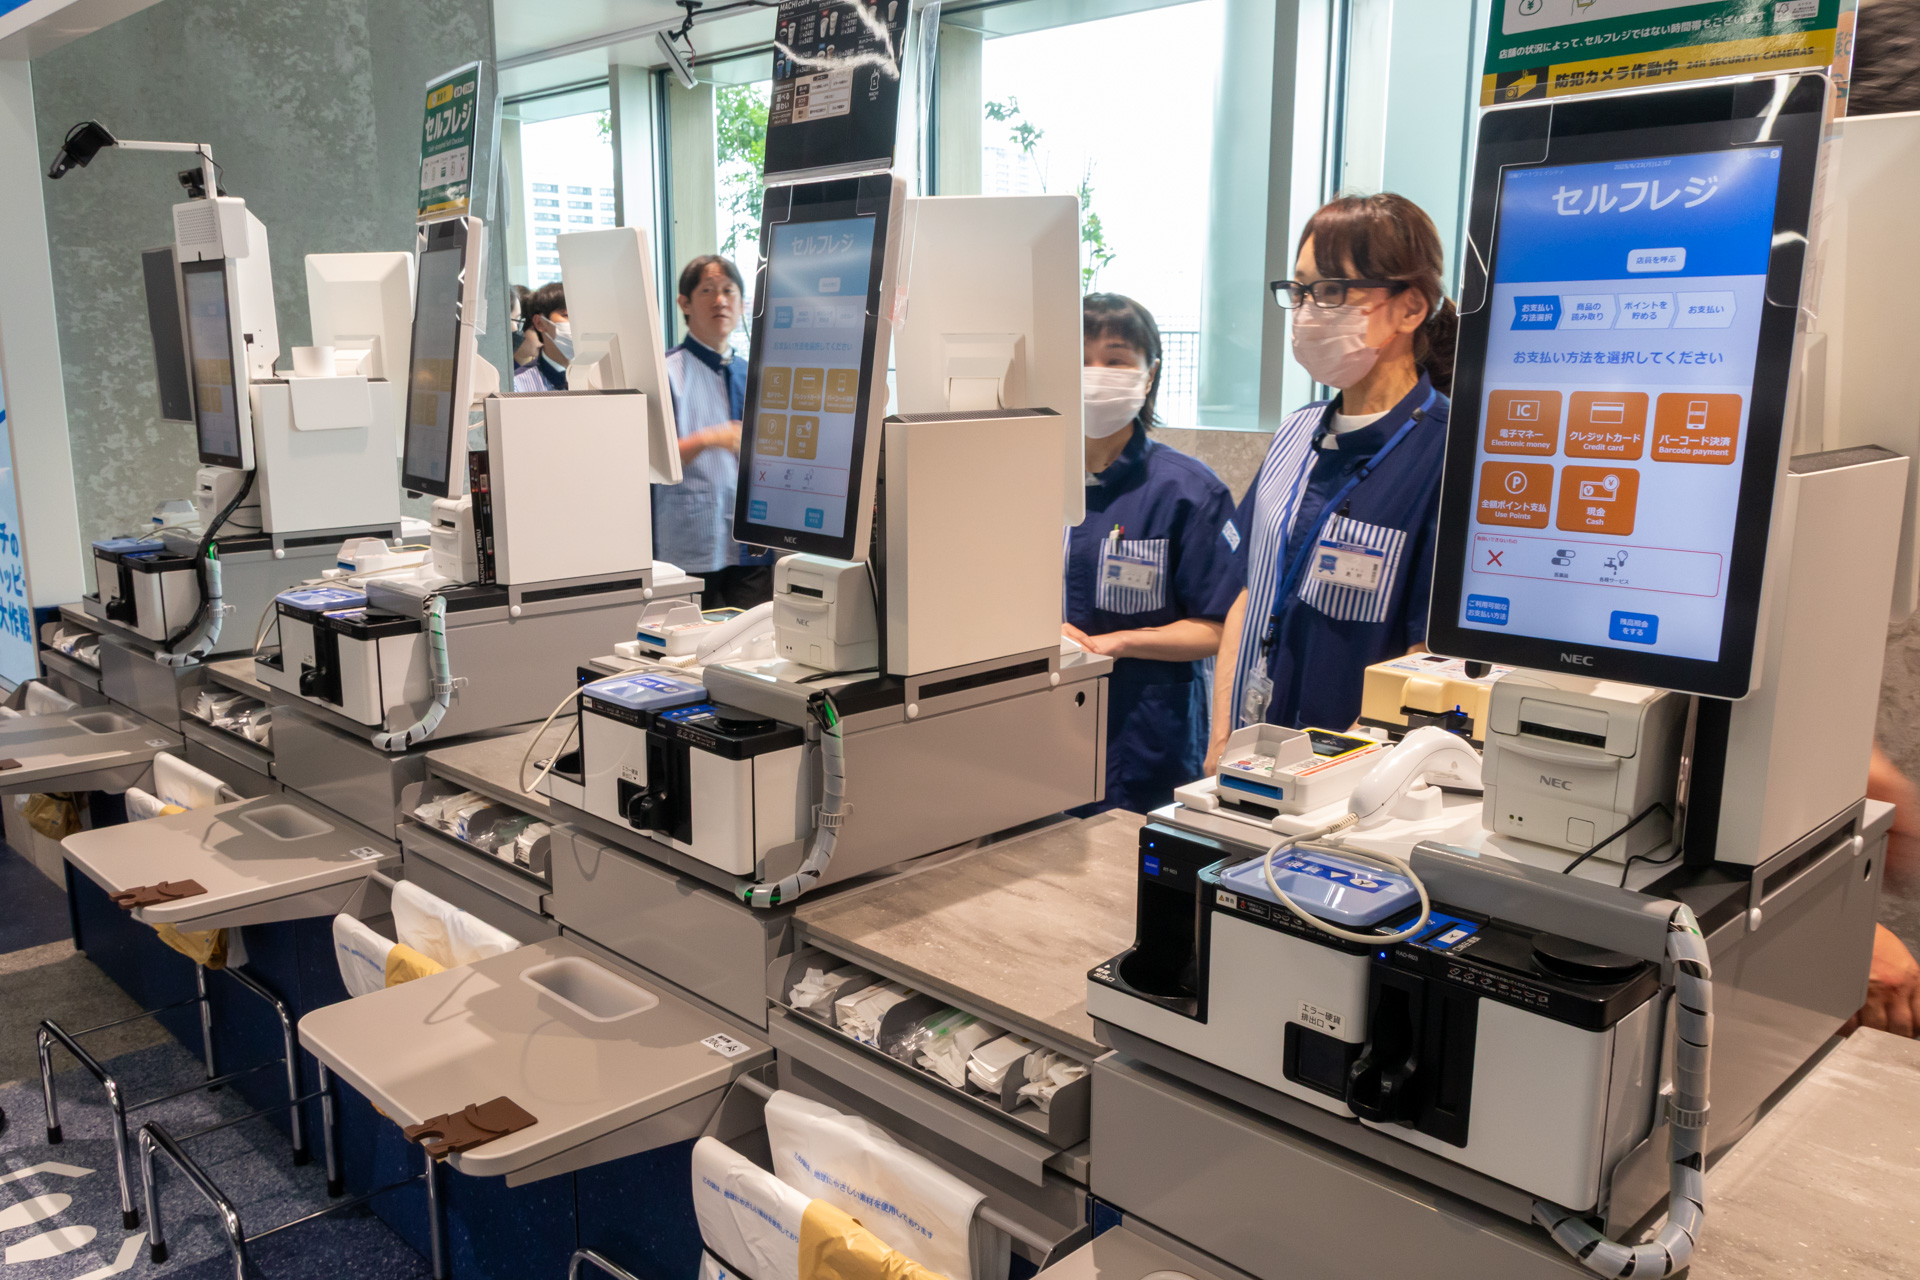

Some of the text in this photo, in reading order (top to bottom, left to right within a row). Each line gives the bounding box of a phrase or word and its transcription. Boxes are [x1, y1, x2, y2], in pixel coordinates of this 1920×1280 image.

[1686, 46, 1814, 69] 24H SECURITY CAMERAS
[1555, 59, 1678, 89] 防犯カメラ作動中
[425, 99, 472, 142] セルフレジ
[1552, 176, 1718, 215] セルフレジ
[792, 233, 854, 256] セルフレジ
[1636, 255, 1677, 265] 店員を呼ぶ
[1521, 303, 1554, 313] お支払い
[1576, 302, 1601, 311] 商品の
[1624, 301, 1668, 310] ポイントを
[1688, 305, 1724, 314] お支払い
[1520, 313, 1553, 322] 方法選択
[1571, 312, 1604, 321] 読み取り
[1632, 311, 1657, 320] 貯める
[1513, 351, 1723, 365] お支払い方法を選択してください
[1516, 404, 1531, 417] IC
[1500, 429, 1543, 438] 電子マネー
[1569, 431, 1641, 444] クレジットカード
[1659, 435, 1731, 447] バーコード決済
[1658, 446, 1729, 456] Barcode payment
[1481, 499, 1547, 513] 全額ポイント支払
[1509, 512, 1531, 520] Points
[1586, 507, 1606, 517] 現金
[1585, 517, 1604, 525] Cash
[784, 535, 797, 544] NEC
[1468, 600, 1508, 611] ご利用可能な
[1467, 609, 1507, 620] お支払い方法
[796, 617, 810, 627] NEC
[1622, 627, 1644, 636] をする
[1560, 652, 1594, 666] NEC
[1539, 774, 1572, 791] NEC
[1302, 1003, 1341, 1025] エラー硬貨
[1301, 1012, 1325, 1028] 排出口
[794, 1152, 933, 1239] この袋は、地球にやさしい素材を使用しております
